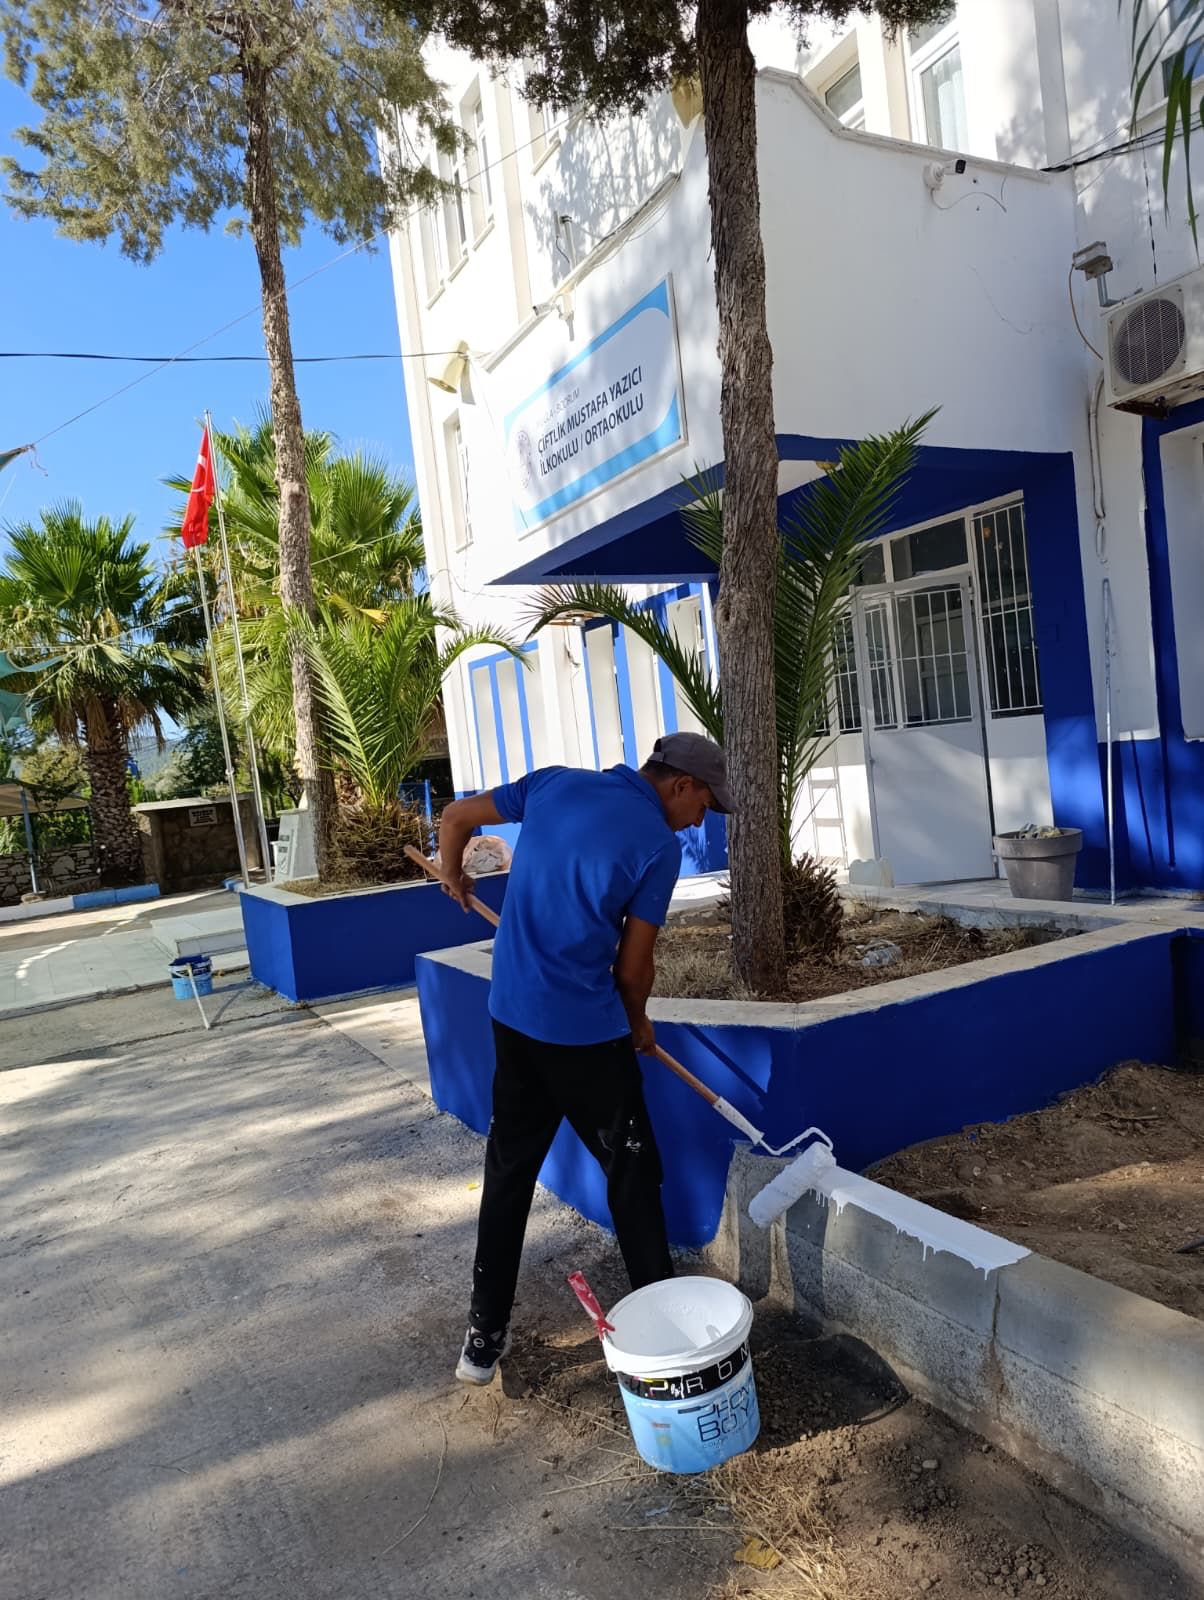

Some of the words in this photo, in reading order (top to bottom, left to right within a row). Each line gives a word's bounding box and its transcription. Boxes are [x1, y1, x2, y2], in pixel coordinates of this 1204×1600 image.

[537, 422, 566, 457] ÇİFTLİK
[567, 391, 609, 433] MUSTAFA
[609, 365, 643, 402] YAZICI
[539, 438, 579, 476] İLKOKULU
[584, 393, 644, 445] ORTAOKULU
